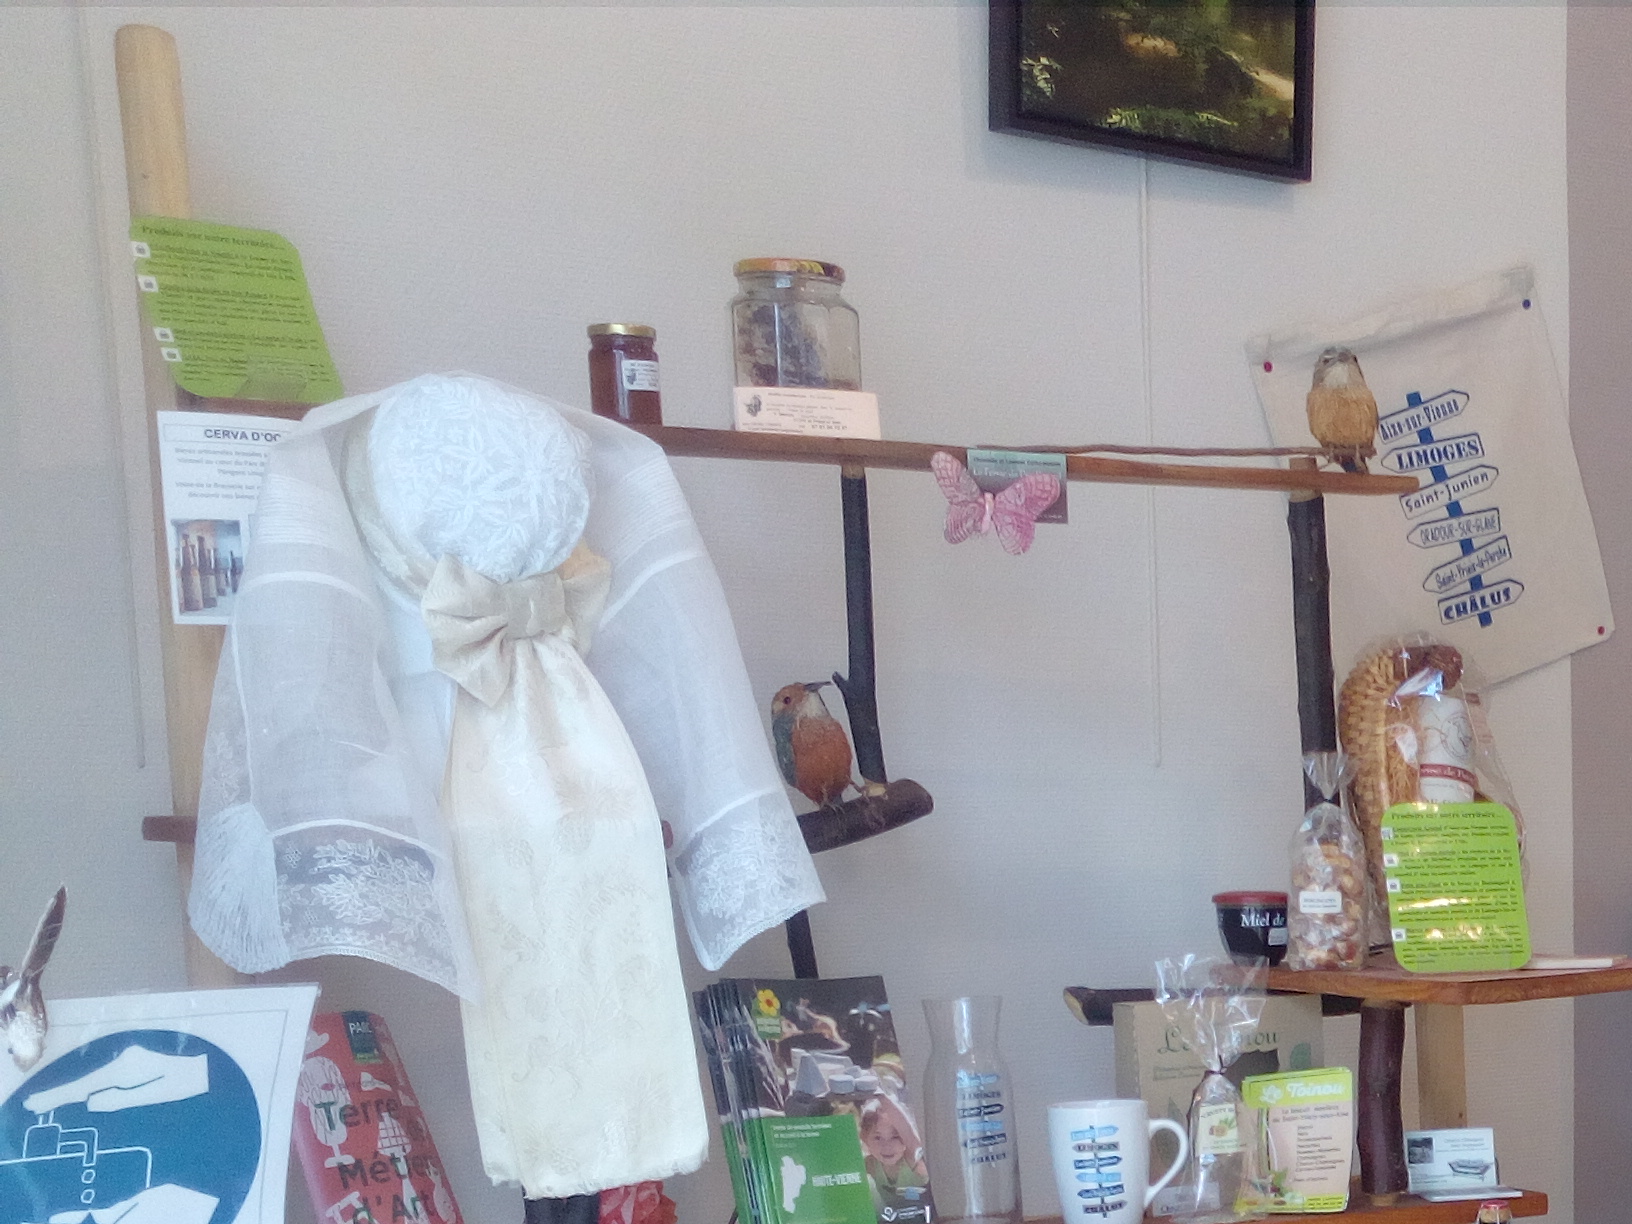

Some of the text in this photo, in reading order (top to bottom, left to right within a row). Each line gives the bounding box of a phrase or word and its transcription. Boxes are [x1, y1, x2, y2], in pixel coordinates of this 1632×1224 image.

[203, 429, 248, 441] CERVA
[1380, 398, 1461, 441] Aixe-sur-Vienne
[1396, 438, 1480, 471] LIMOGES
[1405, 471, 1491, 512] Saint-Junien
[1443, 586, 1512, 621] CHÂLUS
[1241, 911, 1269, 927] Miel
